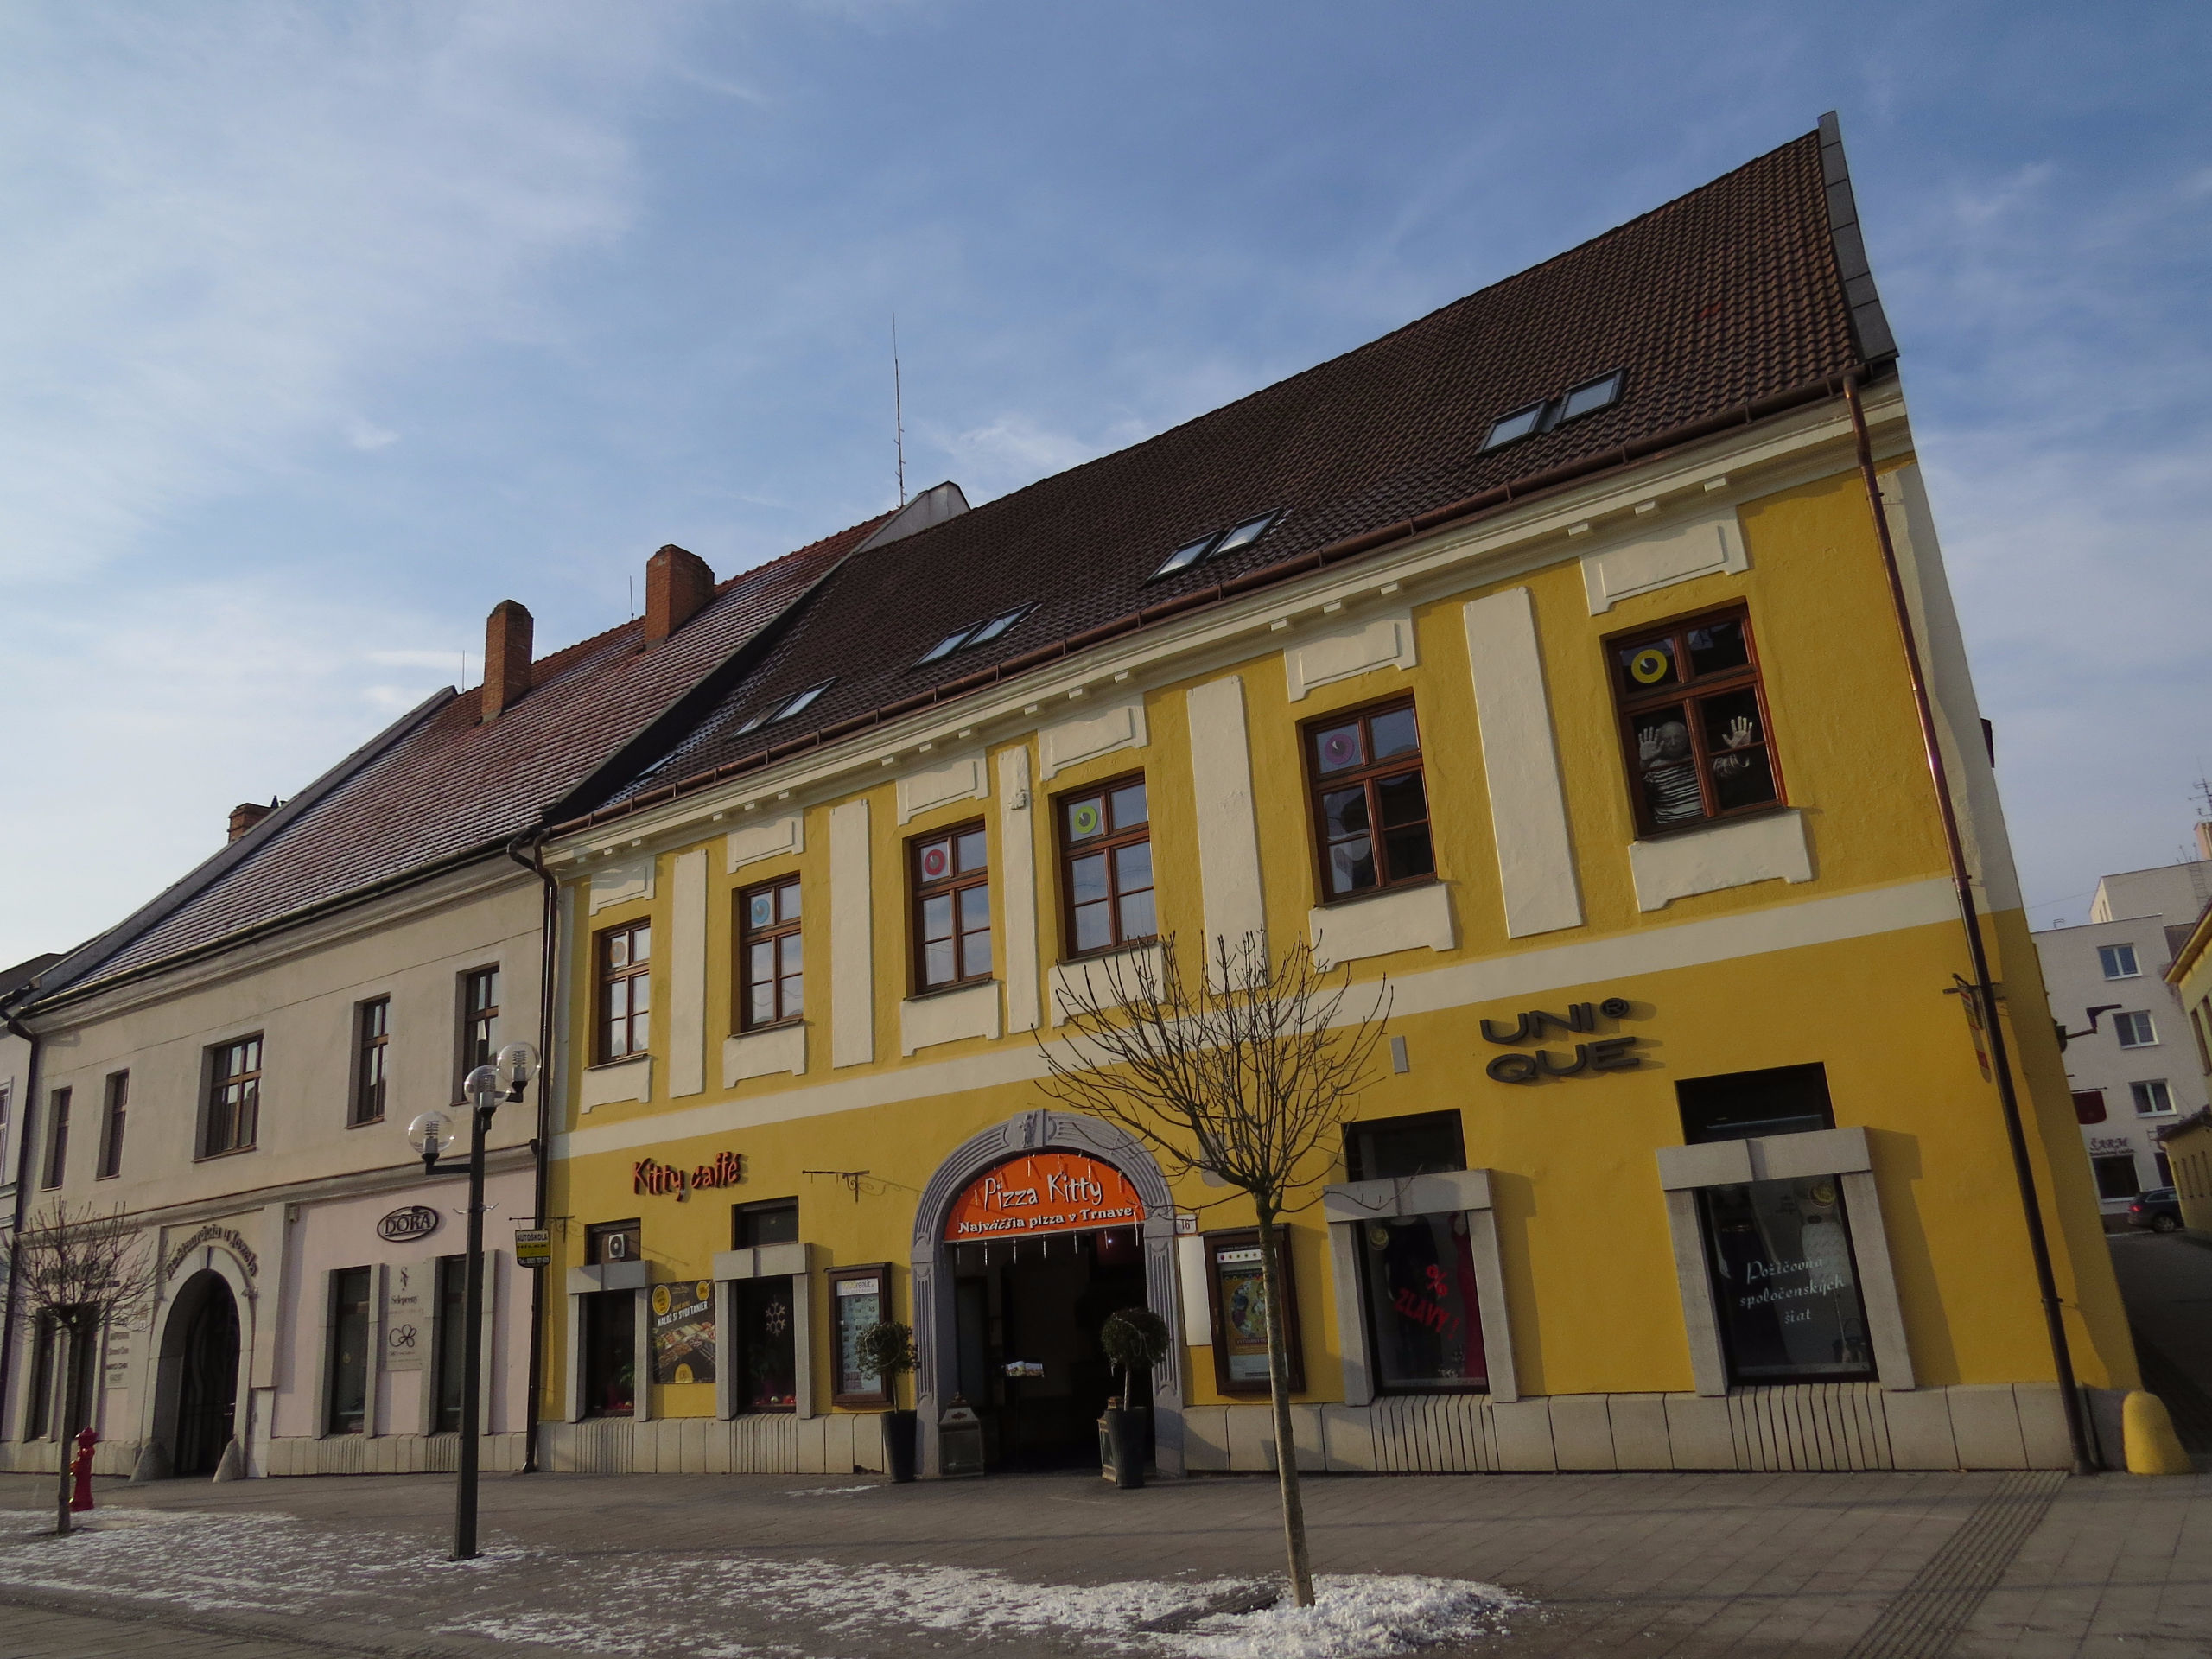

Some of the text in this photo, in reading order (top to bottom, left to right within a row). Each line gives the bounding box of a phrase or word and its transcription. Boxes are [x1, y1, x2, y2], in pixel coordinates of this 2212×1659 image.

[1479, 1002, 1594, 1044] UNI
[1485, 1037, 1640, 1083] QUE
[632, 1151, 742, 1202] Kitty caffé
[982, 1172, 1104, 1211] Pizza Kitty
[385, 1213, 430, 1234] DORA
[957, 1207, 1133, 1234] Najväčšia pizza v Trnave
[1182, 1219, 1191, 1230] 16
[1784, 1309, 1811, 1325] šiat
